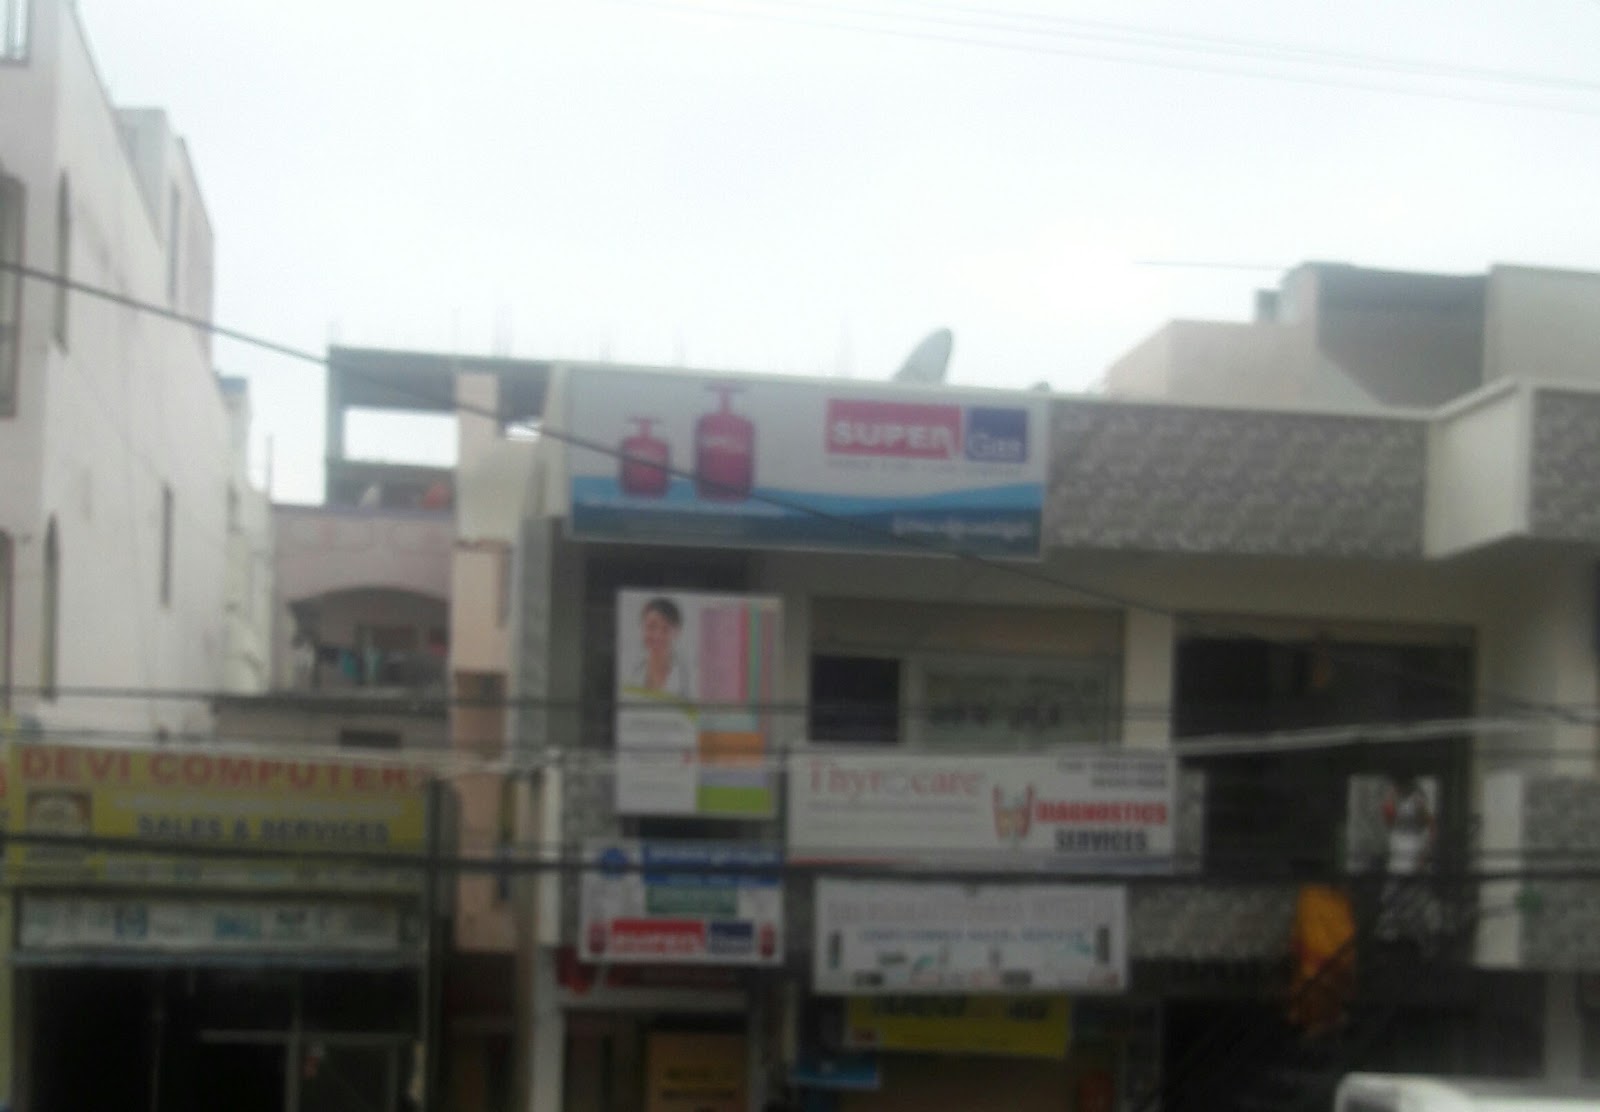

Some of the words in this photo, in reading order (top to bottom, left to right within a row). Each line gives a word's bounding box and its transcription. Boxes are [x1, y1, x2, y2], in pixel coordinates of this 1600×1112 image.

[833, 420, 958, 455] SUPER
[21, 746, 132, 785] DEVI
[1037, 801, 1168, 825] DIAGNOSTICS
[138, 814, 224, 842] SALES
[261, 818, 391, 845] SERVICES
[1054, 829, 1148, 853] SERVICES
